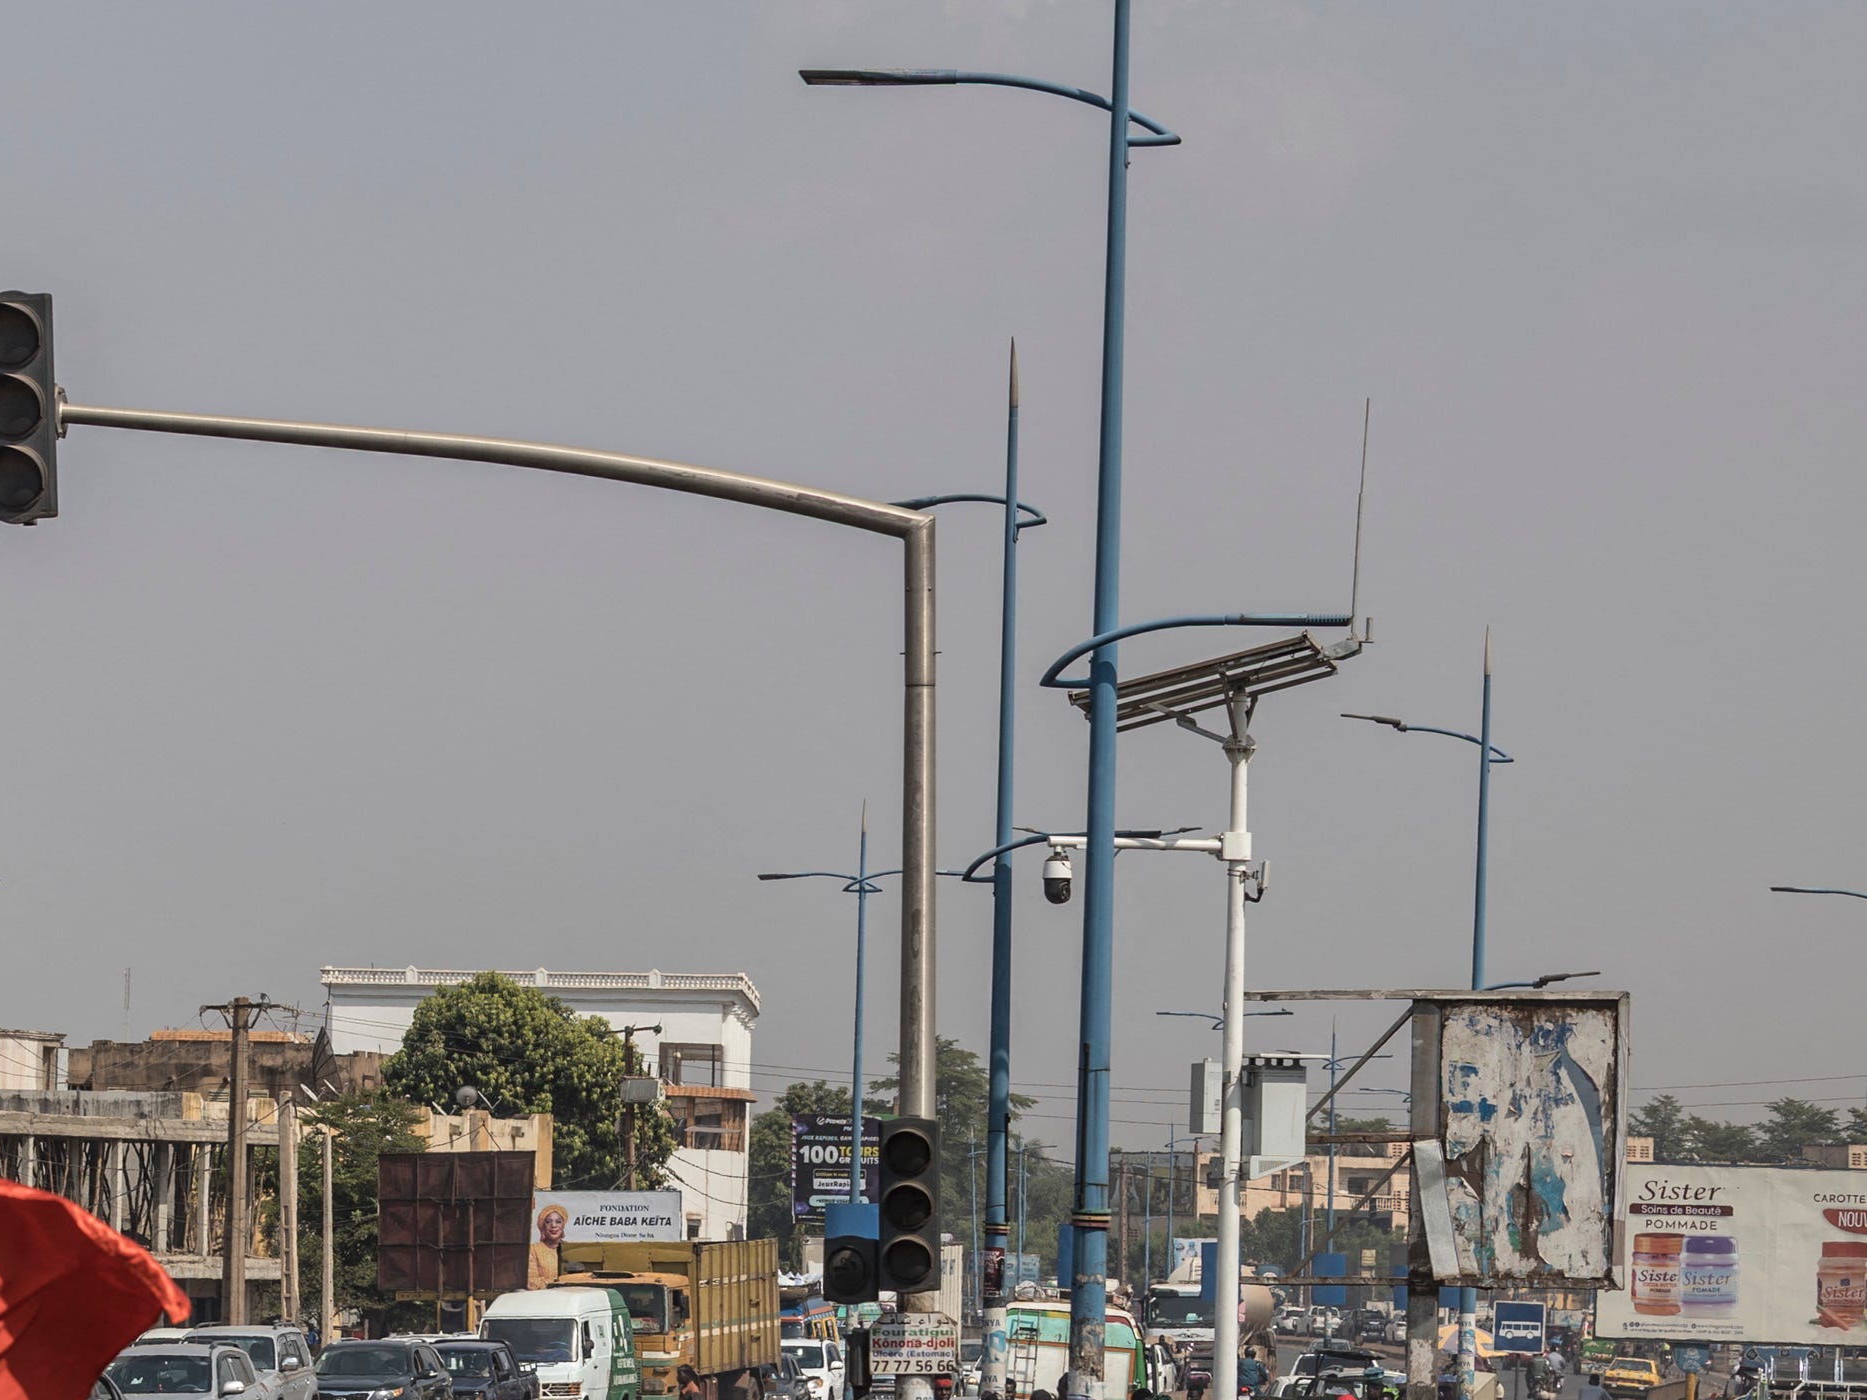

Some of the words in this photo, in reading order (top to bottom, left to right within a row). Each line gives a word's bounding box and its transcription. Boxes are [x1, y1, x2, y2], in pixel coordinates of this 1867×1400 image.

[799, 1145, 839, 1164] 100
[1638, 1180, 1722, 1201] Sister
[1814, 1193, 1866, 1203] CAROTTE
[599, 1204, 650, 1212] FONDATION
[1641, 1204, 1668, 1215] Soins
[1670, 1205, 1683, 1215] de
[1685, 1206, 1722, 1216] Beauté
[609, 1217, 638, 1226] BABA
[640, 1215, 672, 1226] KEÏTA
[1646, 1219, 1718, 1231] POMMADE
[1638, 1269, 1679, 1282] Siste
[1682, 1271, 1731, 1286] Sister
[1824, 1286, 1865, 1298] Sister
[873, 1361, 889, 1372] 77
[894, 1361, 911, 1372] 77
[916, 1361, 933, 1372] 56
[937, 1361, 954, 1372] 66
